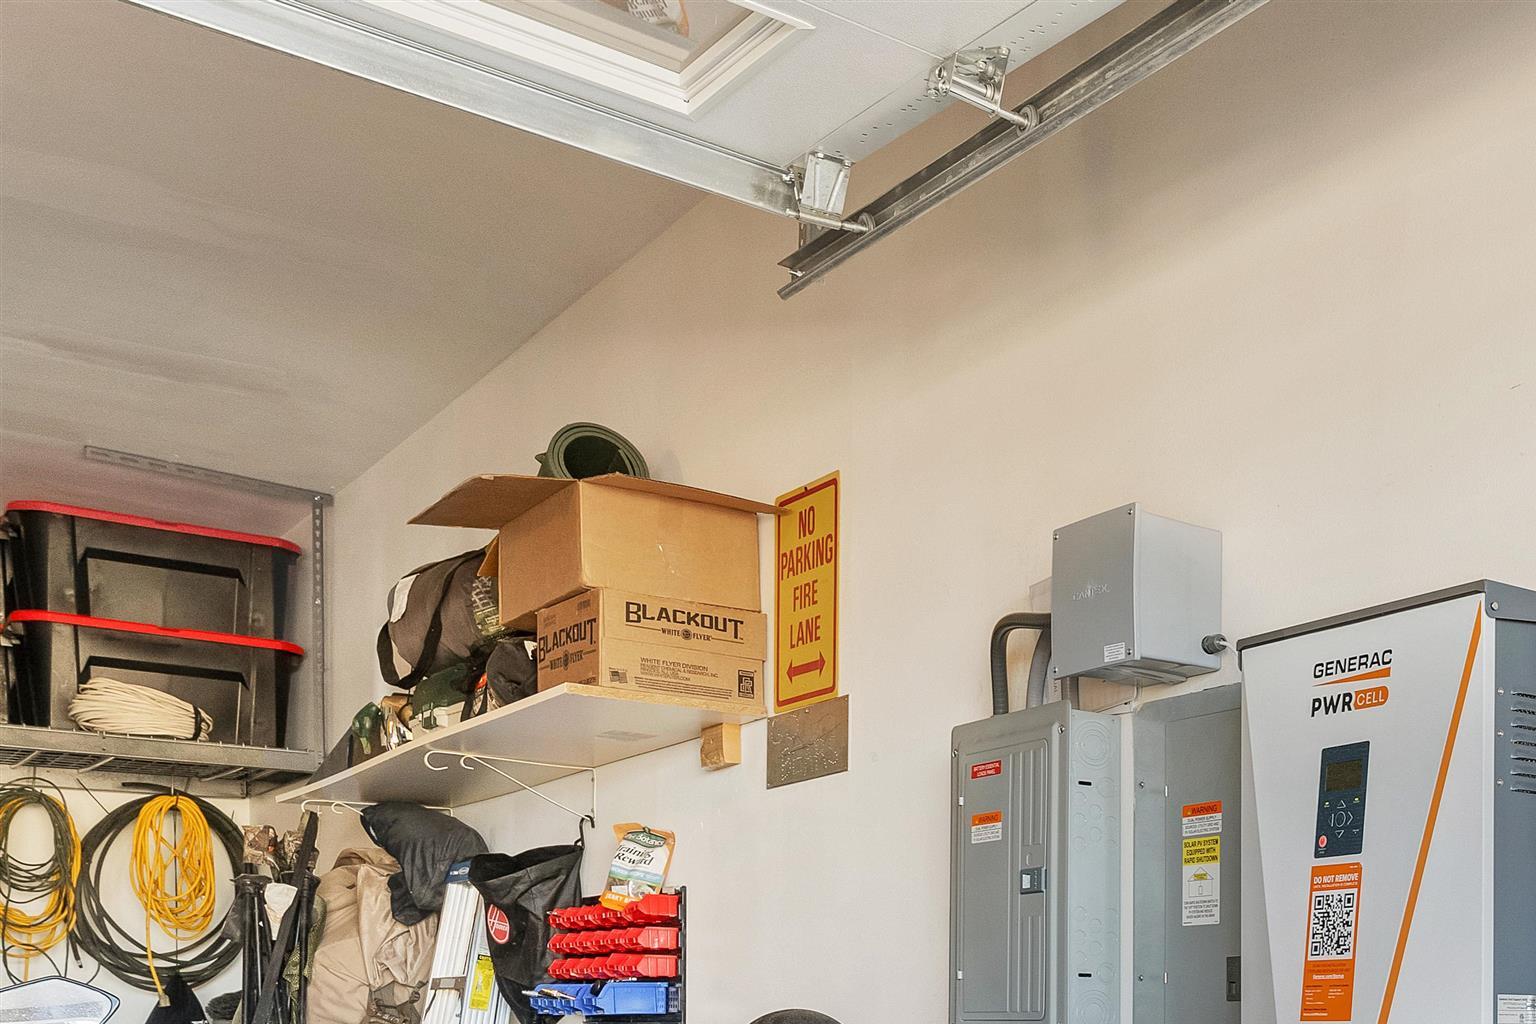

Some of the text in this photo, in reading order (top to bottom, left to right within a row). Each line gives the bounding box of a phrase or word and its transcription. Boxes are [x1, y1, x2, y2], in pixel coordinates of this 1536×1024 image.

[798, 505, 815, 540] NO
[780, 533, 833, 581] PARKING
[793, 579, 818, 612] FIRE
[625, 601, 744, 640] BLACKOUT
[661, 627, 681, 638] WHITE
[789, 615, 821, 649] LANE
[538, 618, 597, 663] BLACKOUT
[640, 656, 709, 672] WHITE FLYER DIVISION
[1313, 649, 1393, 679] GENERAC
[1192, 804, 1217, 815] WARNING
[978, 814, 999, 823] WARNING
[1183, 840, 1196, 848] SOLAR
[1203, 838, 1219, 846] SYSTEM
[1186, 846, 1216, 856] EQUIPPED WITH
[1183, 854, 1218, 864] RAPID SHUTDOWN
[1313, 872, 1359, 885] DO NOT REMOVE
